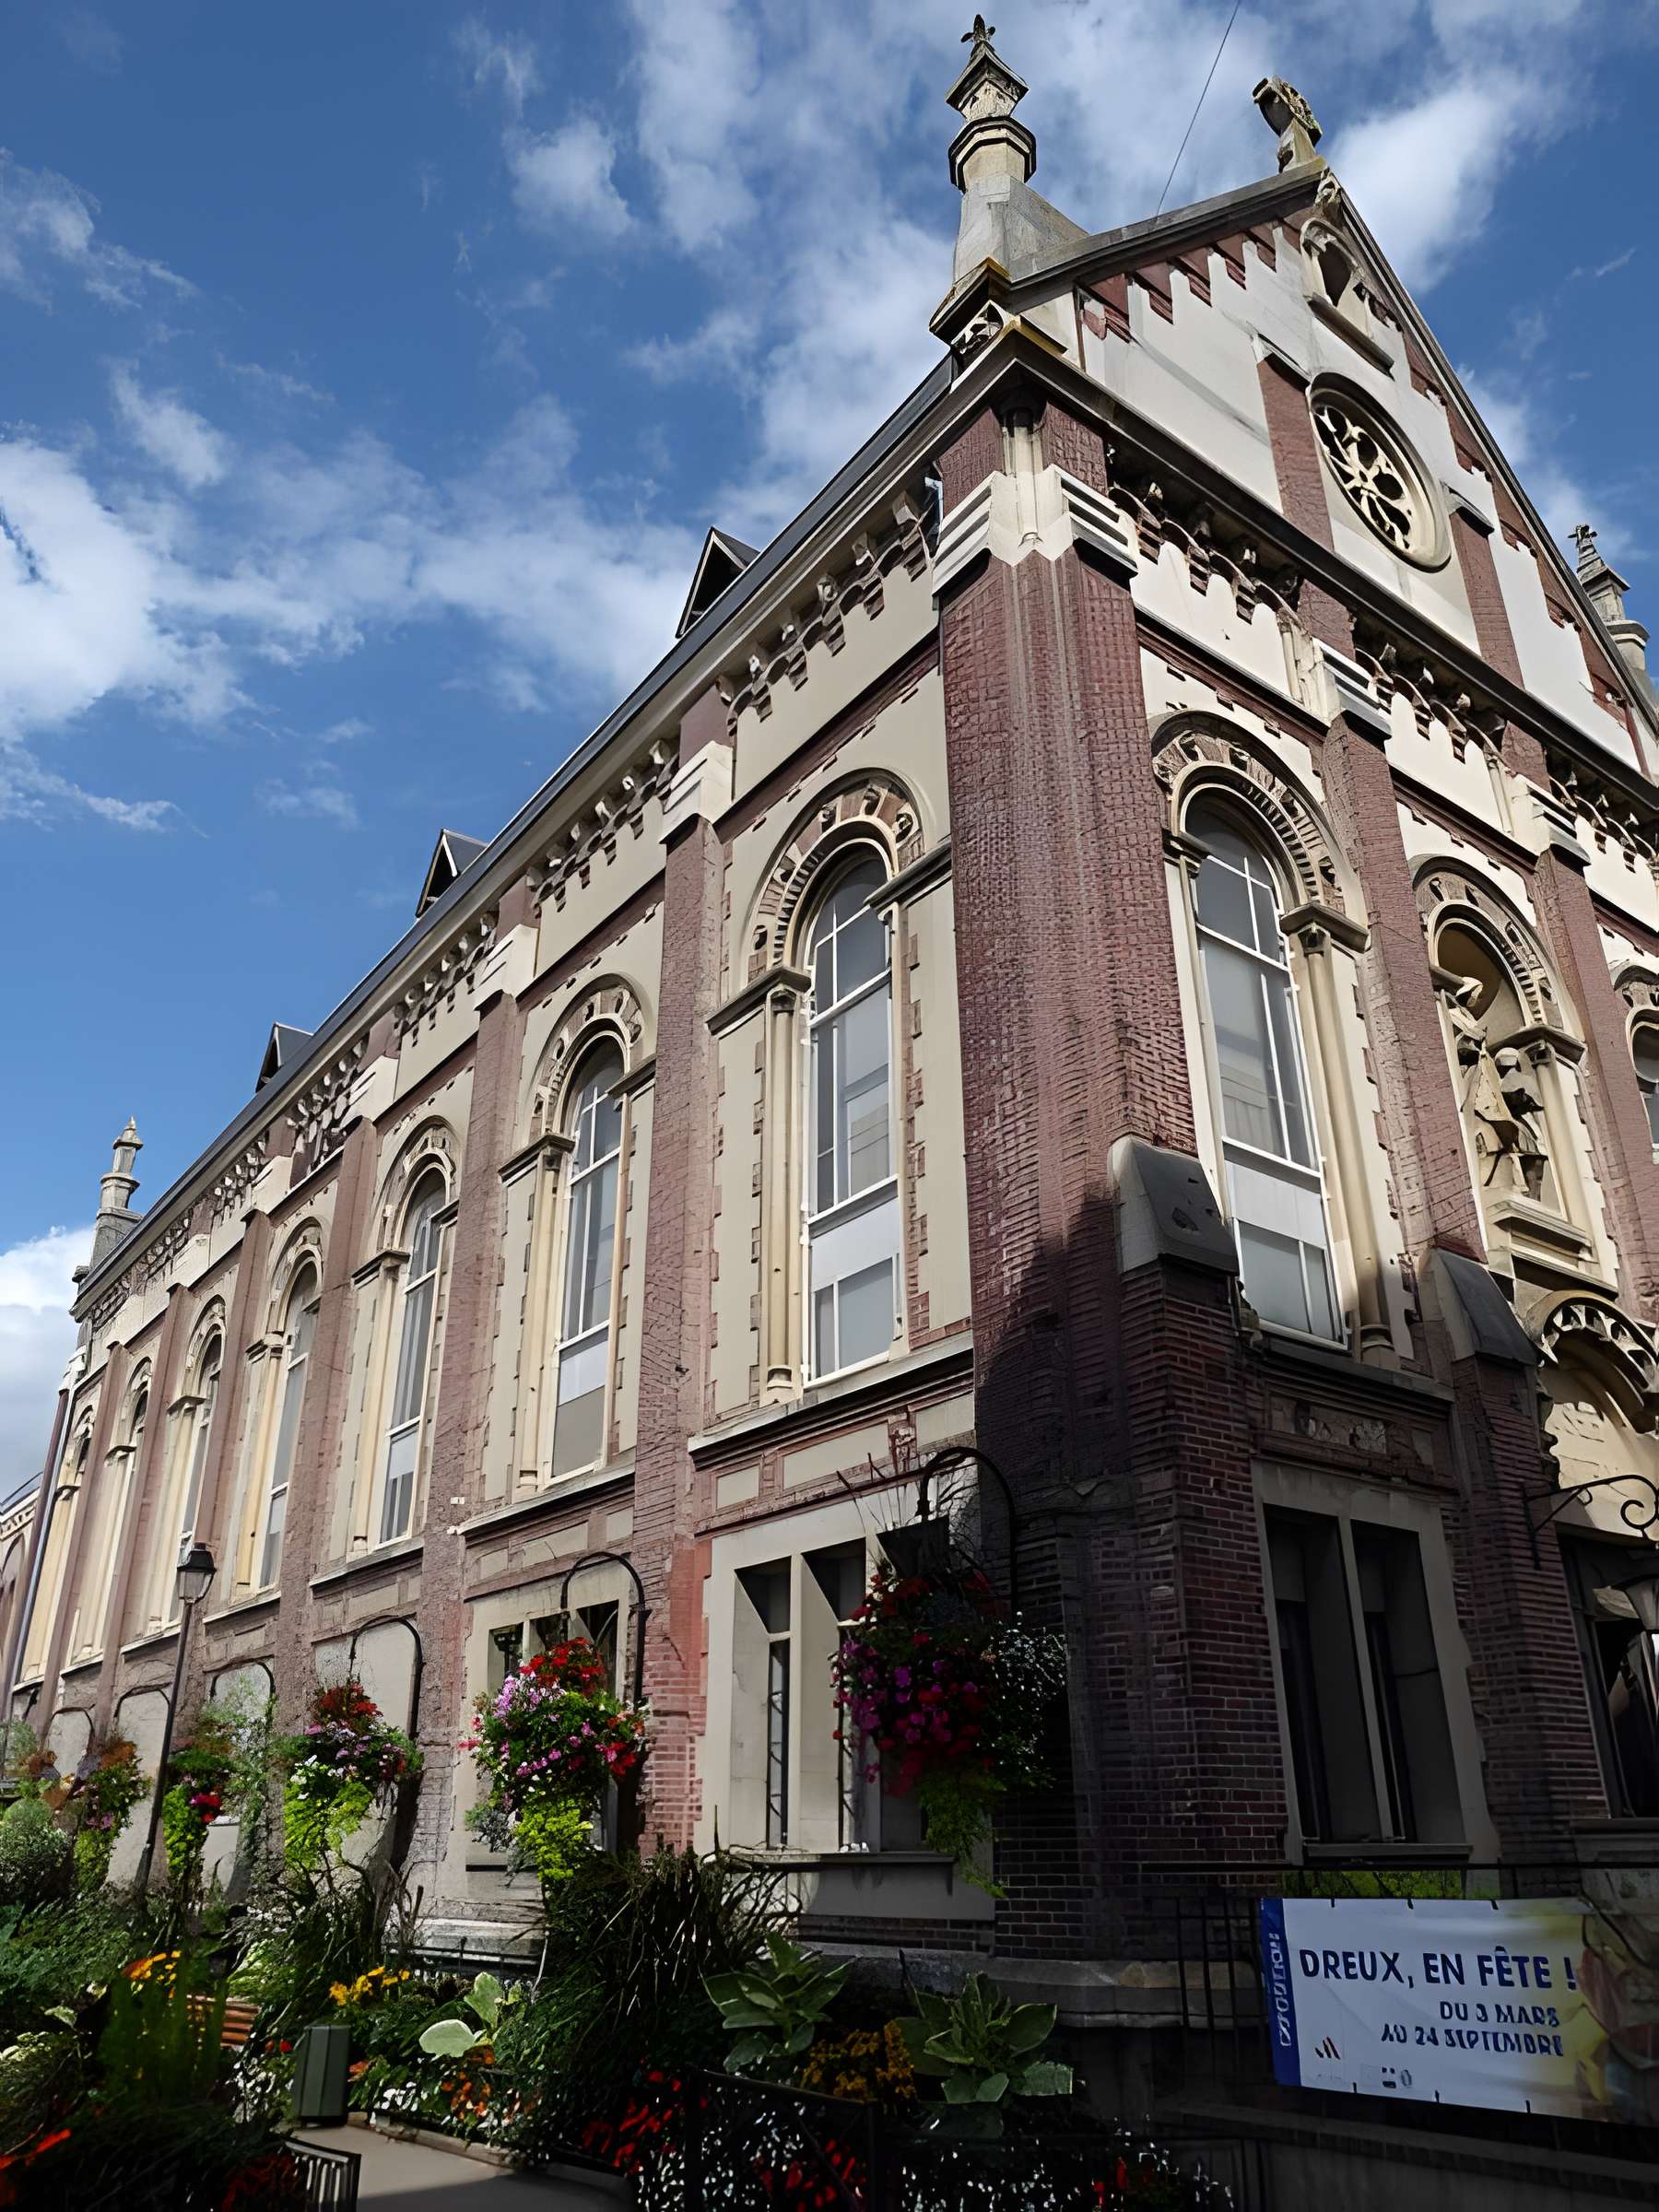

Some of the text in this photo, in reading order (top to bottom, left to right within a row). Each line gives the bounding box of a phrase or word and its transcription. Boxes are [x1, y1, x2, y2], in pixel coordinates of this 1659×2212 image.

[1300, 1948, 1414, 1989] DREUX,
[1423, 1952, 1465, 1986] EN
[1477, 1945, 1552, 1989] FÊTE
[1440, 2001, 1469, 2020] DU
[1495, 2005, 1559, 2028] MARS
[1381, 2024, 1407, 2043] AU
